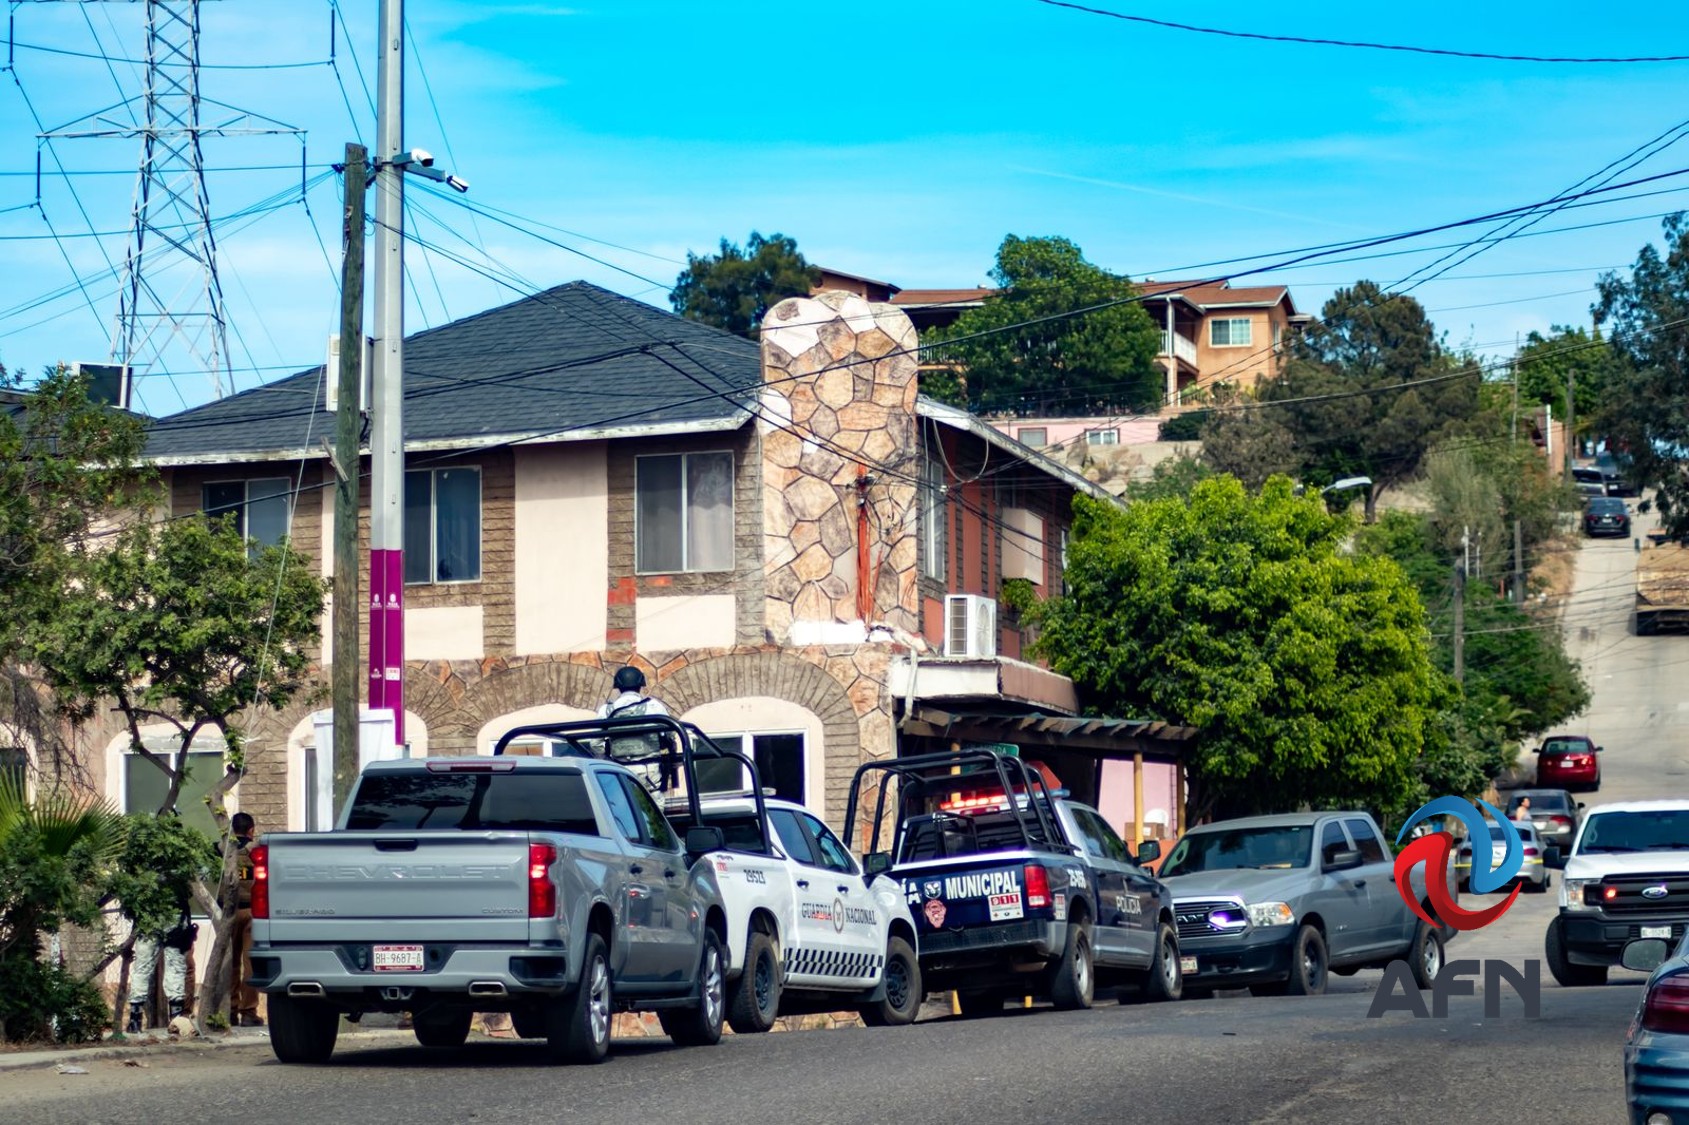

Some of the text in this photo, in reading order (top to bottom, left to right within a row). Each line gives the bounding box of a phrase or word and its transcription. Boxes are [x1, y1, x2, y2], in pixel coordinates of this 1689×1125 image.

[284, 864, 509, 879] CHEVROLET
[945, 870, 1021, 900] MUNICIPAL
[991, 894, 1019, 906] 911
[802, 903, 877, 925] GUARDIA NACIONAL
